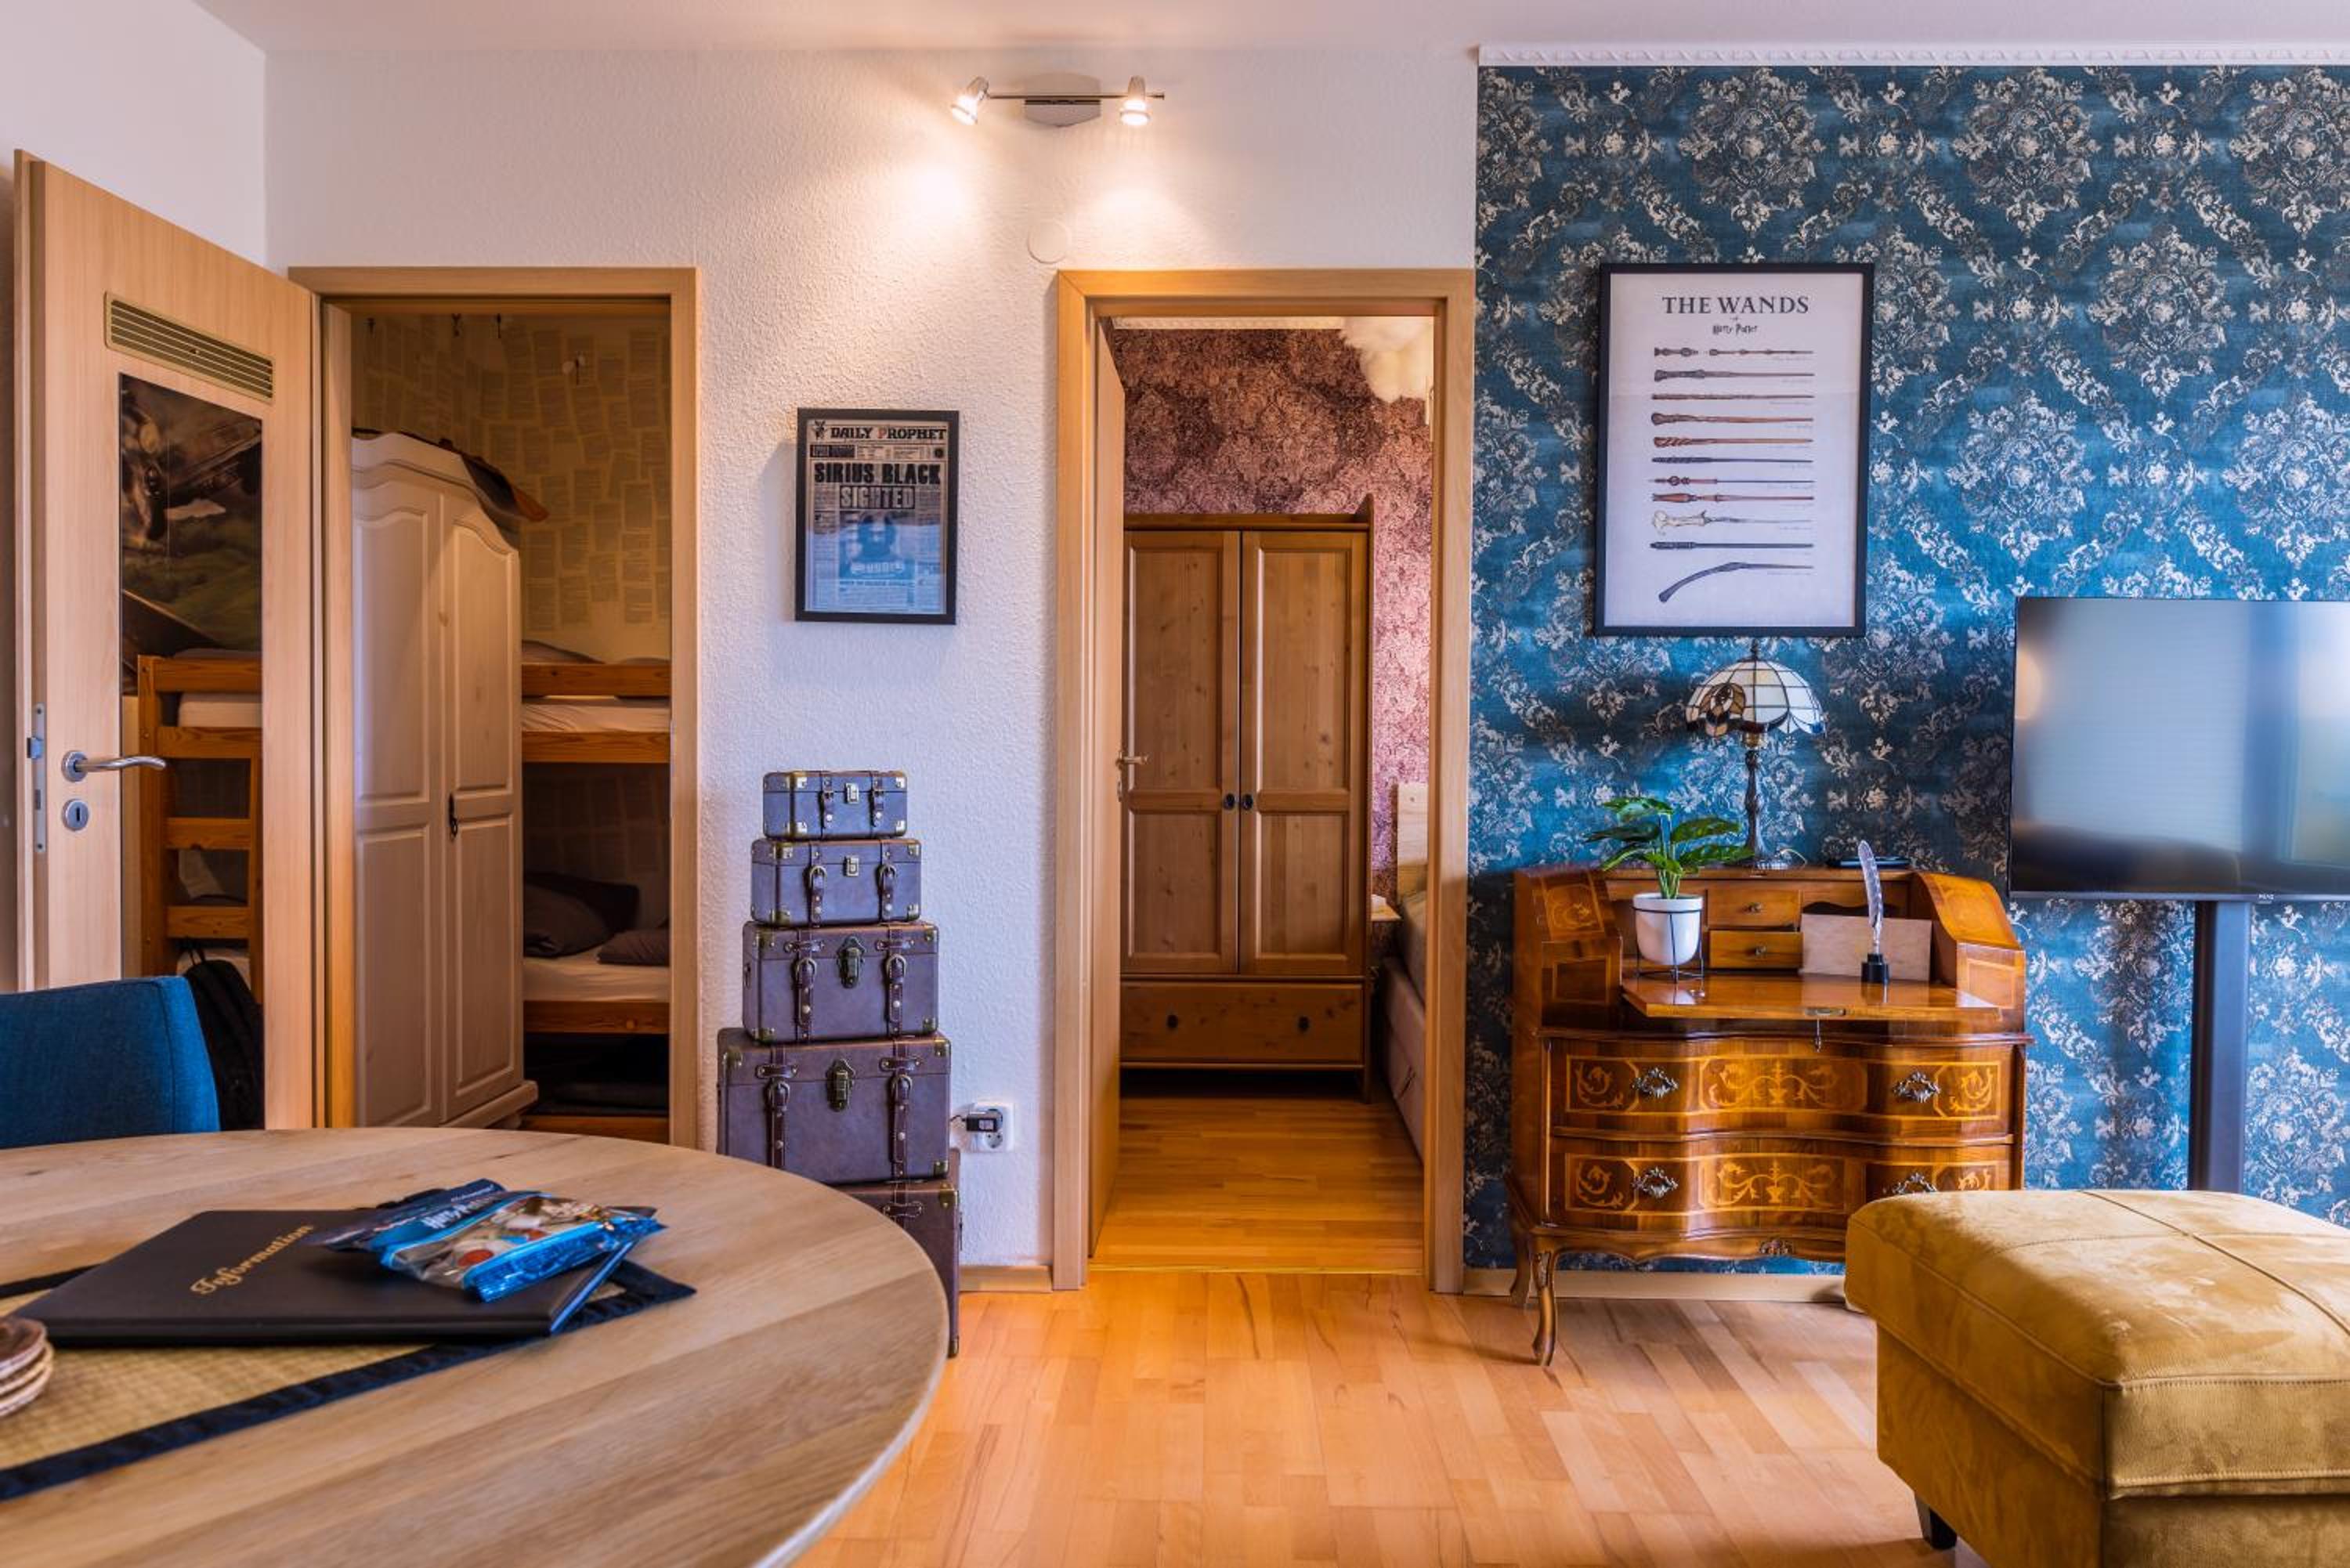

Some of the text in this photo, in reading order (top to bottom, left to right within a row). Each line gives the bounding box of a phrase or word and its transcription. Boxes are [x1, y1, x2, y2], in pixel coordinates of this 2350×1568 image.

[1661, 296, 1810, 314] THE WANDS
[1712, 323, 1758, 334] Harry Potter
[830, 427, 947, 439] DAILY PROPHET
[814, 462, 941, 484] SIRIUS BLACK
[841, 486, 914, 508] SIGHTED
[190, 1225, 314, 1295] Information
